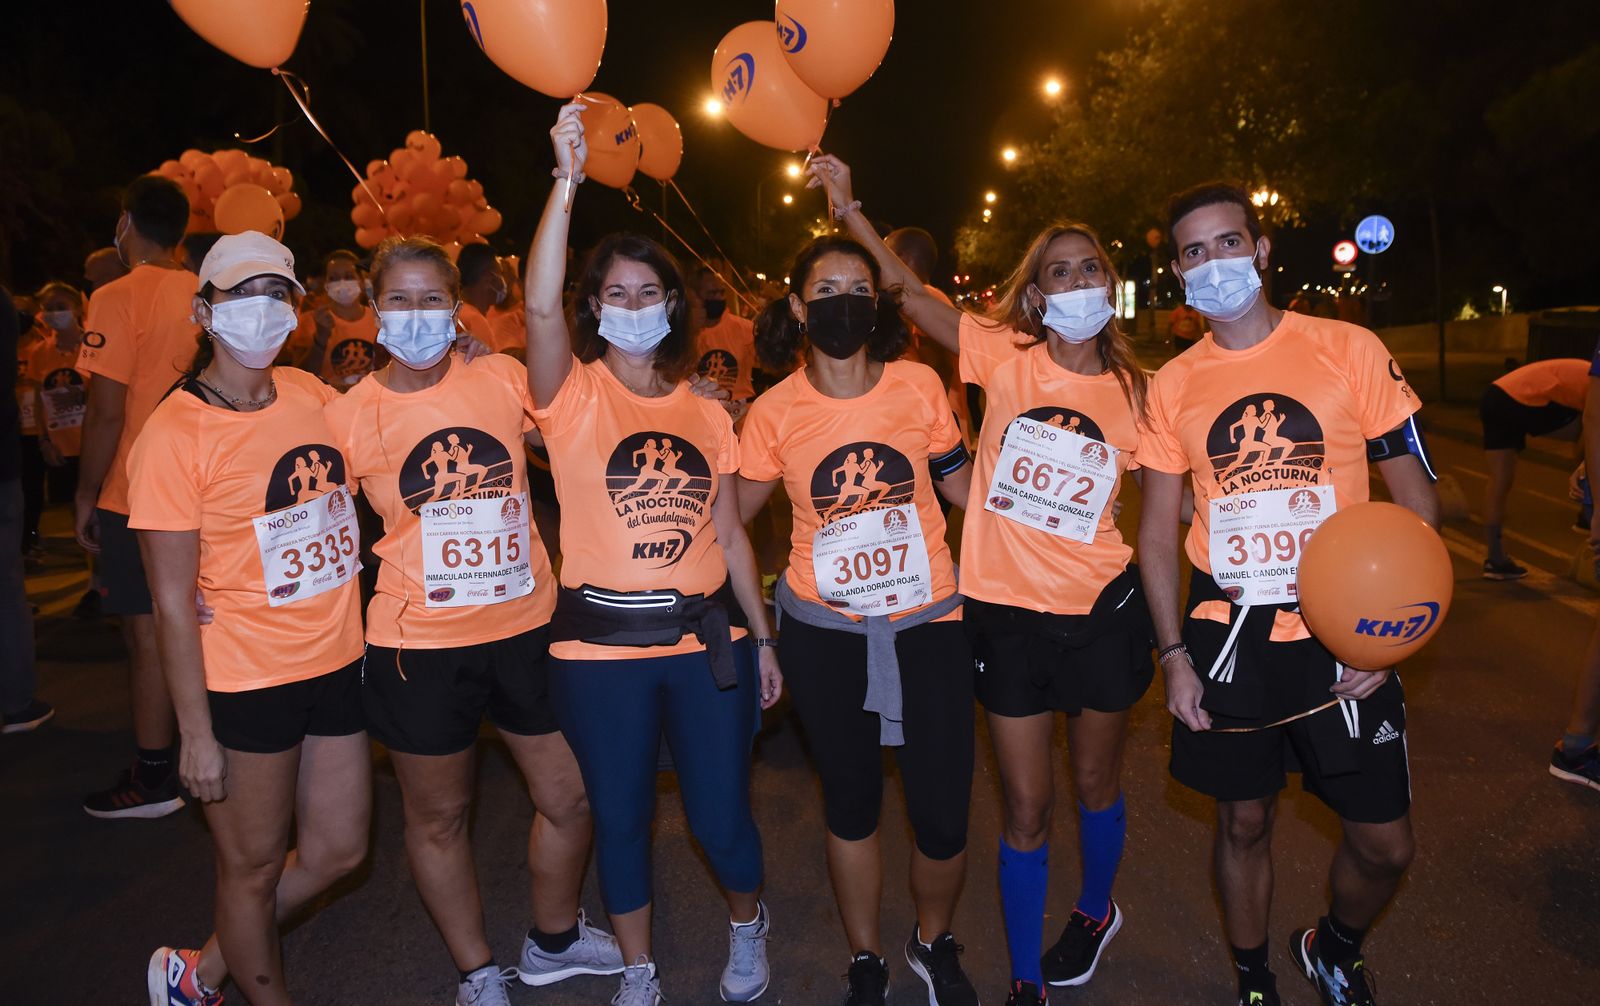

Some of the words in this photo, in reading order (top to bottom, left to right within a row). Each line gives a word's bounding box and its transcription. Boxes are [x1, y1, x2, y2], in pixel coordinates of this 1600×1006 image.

[1012, 456, 1095, 505] 6672
[1222, 481, 1240, 496] LA
[1240, 468, 1319, 486] NOCTURNA
[615, 504, 633, 518] LA
[636, 497, 704, 517] NOCTURNA
[998, 482, 1018, 494] MARIA
[1019, 490, 1056, 509] CARDENAS
[1058, 504, 1095, 520] GONZALEZ
[627, 516, 640, 529] del
[642, 511, 696, 528] Guadalquivir
[281, 525, 354, 579] 3335
[442, 533, 520, 568] 6315
[426, 572, 473, 581] INMACULADA
[474, 568, 512, 579] FERNNADEZ
[513, 562, 529, 573] TEJADA
[832, 543, 910, 585] 3097
[1219, 570, 1252, 580] MANUEL
[1253, 566, 1288, 578] CANDÓN
[831, 586, 866, 598] YOLANDA
[866, 580, 896, 592] DORADO
[896, 574, 920, 586] ROJAS
[1373, 730, 1400, 744] adidas
